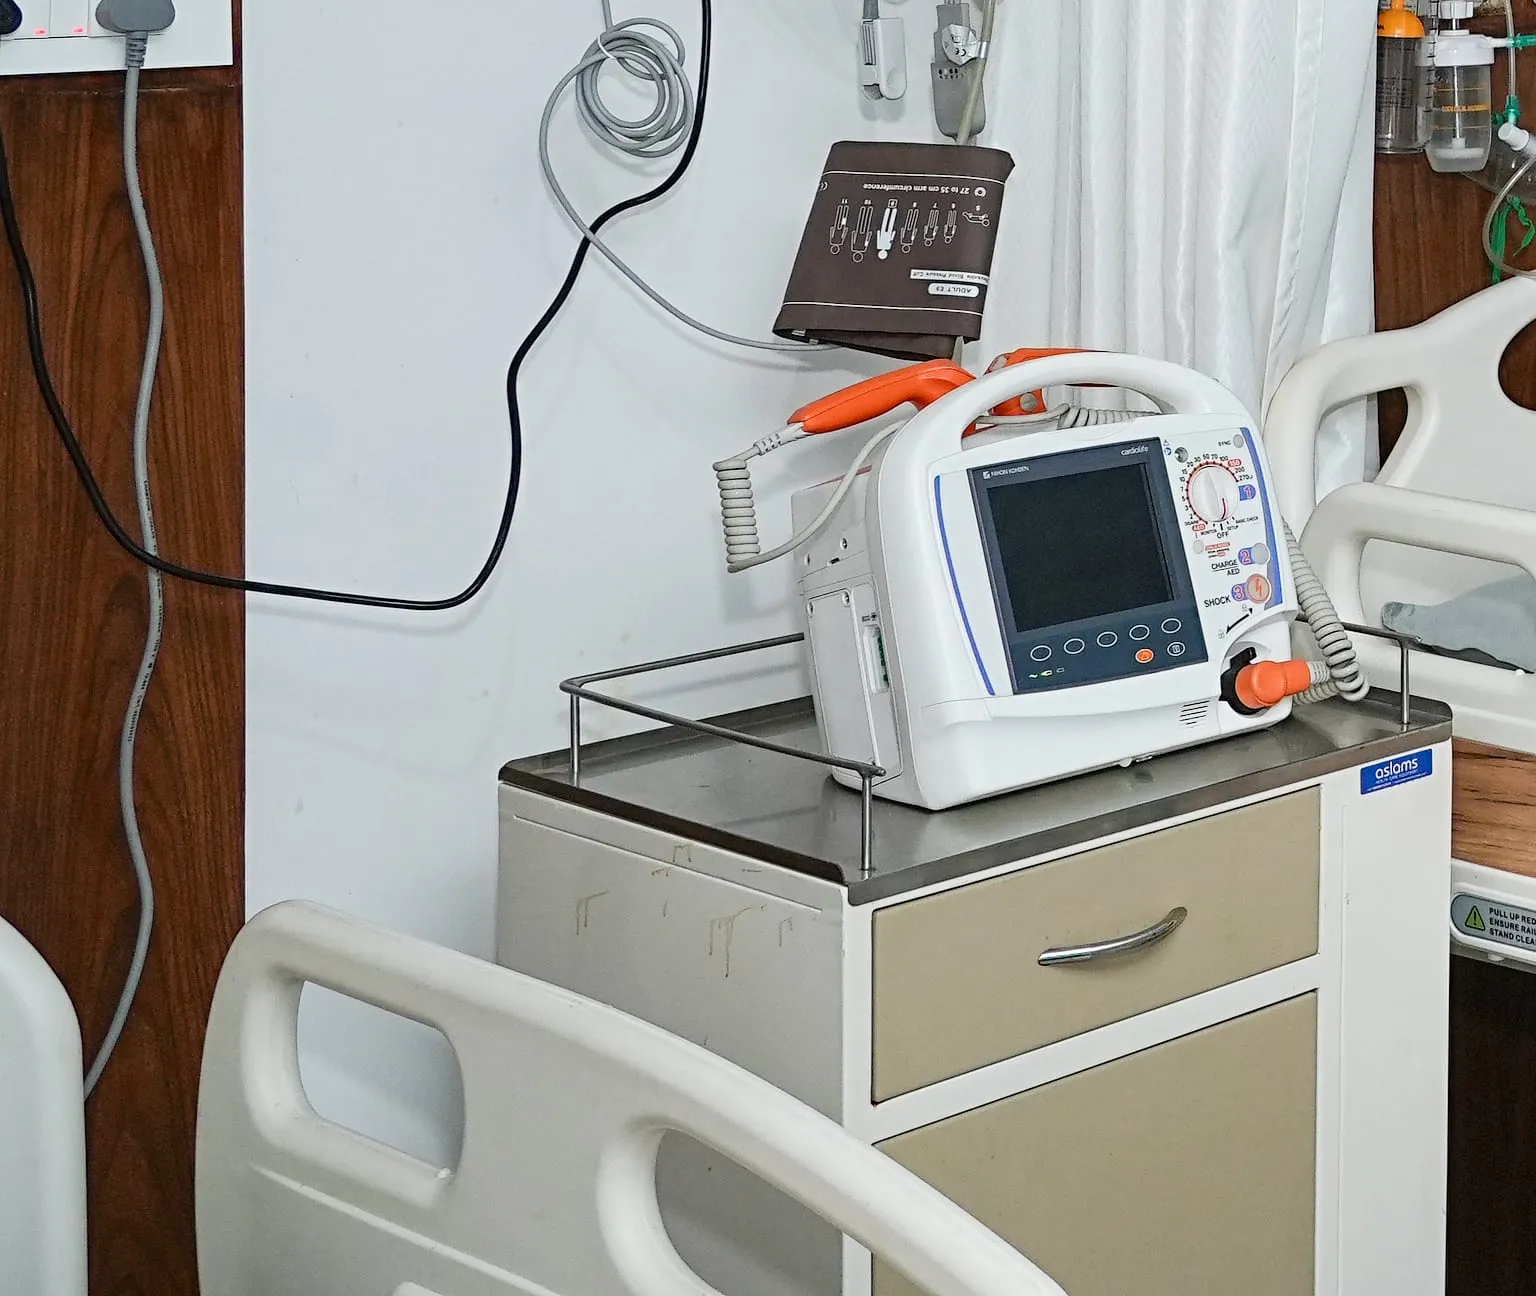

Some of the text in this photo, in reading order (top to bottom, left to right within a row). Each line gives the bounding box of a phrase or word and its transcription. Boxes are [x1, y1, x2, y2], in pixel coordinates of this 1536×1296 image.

[1241, 550, 1250, 563] 2
[1211, 559, 1238, 570] CHARGE
[1226, 568, 1240, 576] AED
[1233, 586, 1244, 599] 3
[1203, 595, 1231, 608] SHOCK
[1375, 757, 1418, 779] aslams
[1489, 907, 1508, 918] PULL
[1509, 912, 1520, 921] UP
[1521, 915, 1536, 925] RED
[1489, 917, 1520, 931] ENSURE
[1489, 927, 1514, 940] STAND
